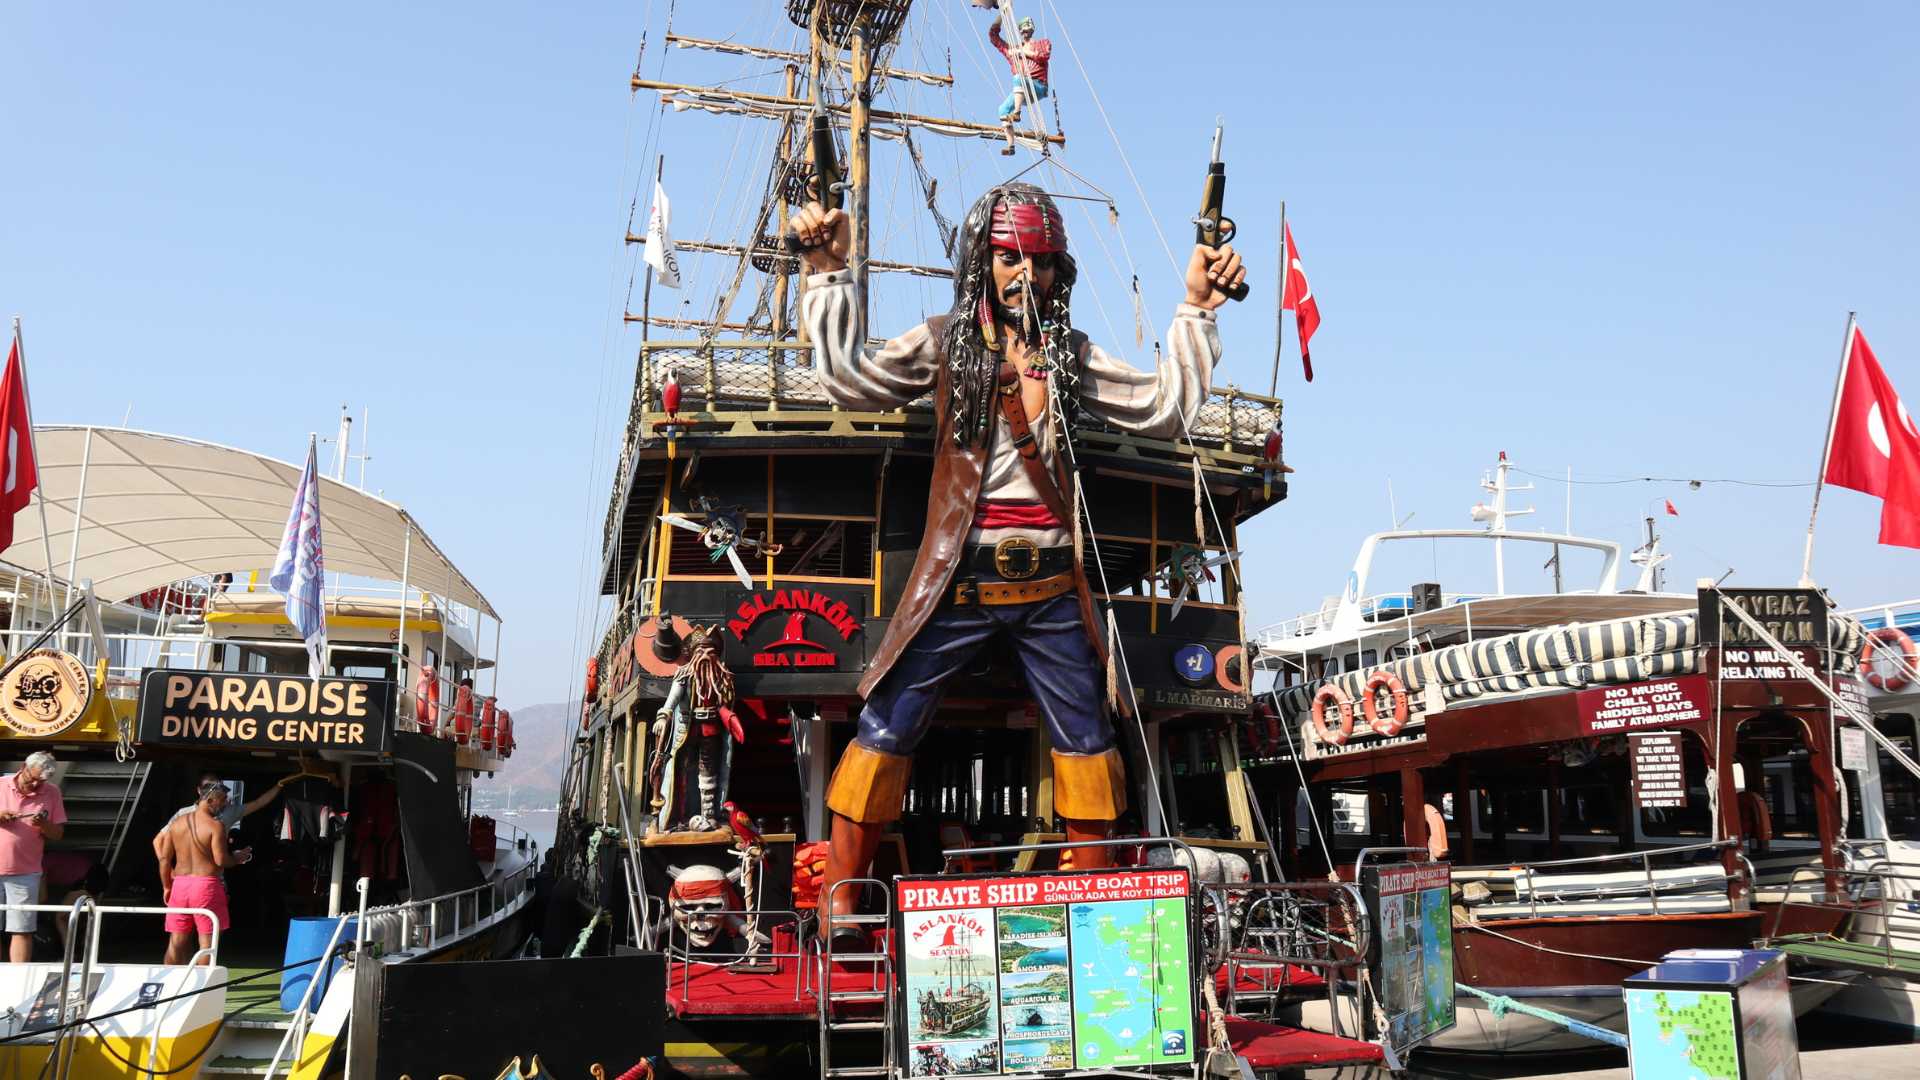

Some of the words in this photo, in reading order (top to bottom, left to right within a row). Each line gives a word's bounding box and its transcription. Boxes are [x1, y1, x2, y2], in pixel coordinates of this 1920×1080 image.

[727, 590, 861, 641] ASLANKÖK
[754, 653, 790, 666] SEA
[794, 653, 837, 666] LION
[1725, 651, 1750, 663] NO
[1720, 667, 1786, 679] RELAXING
[1787, 667, 1815, 679] TRP
[164, 675, 369, 717] PARADISE
[1605, 688, 1628, 699] NO
[1632, 682, 1679, 696] MUSIC
[1604, 697, 1648, 708] CHILL
[1652, 692, 1682, 703] OUT
[1596, 705, 1652, 719] HIDDEN
[1656, 701, 1693, 713] BAYS
[162, 715, 258, 741] DIVING
[267, 720, 365, 744] CENTER
[1592, 719, 1626, 730] FAMILY
[1044, 879, 1093, 892] DAILY
[1096, 876, 1142, 890] BOAT
[1146, 874, 1184, 886] TRIP
[903, 886, 981, 908] PIRATE
[987, 883, 1038, 904] SHIP
[1044, 892, 1083, 903] GÜNLÜK
[1086, 891, 1106, 900] ADA
[1108, 890, 1120, 899] VE
[1122, 889, 1143, 898] KOY
[912, 914, 986, 942] ASLANKÖK
